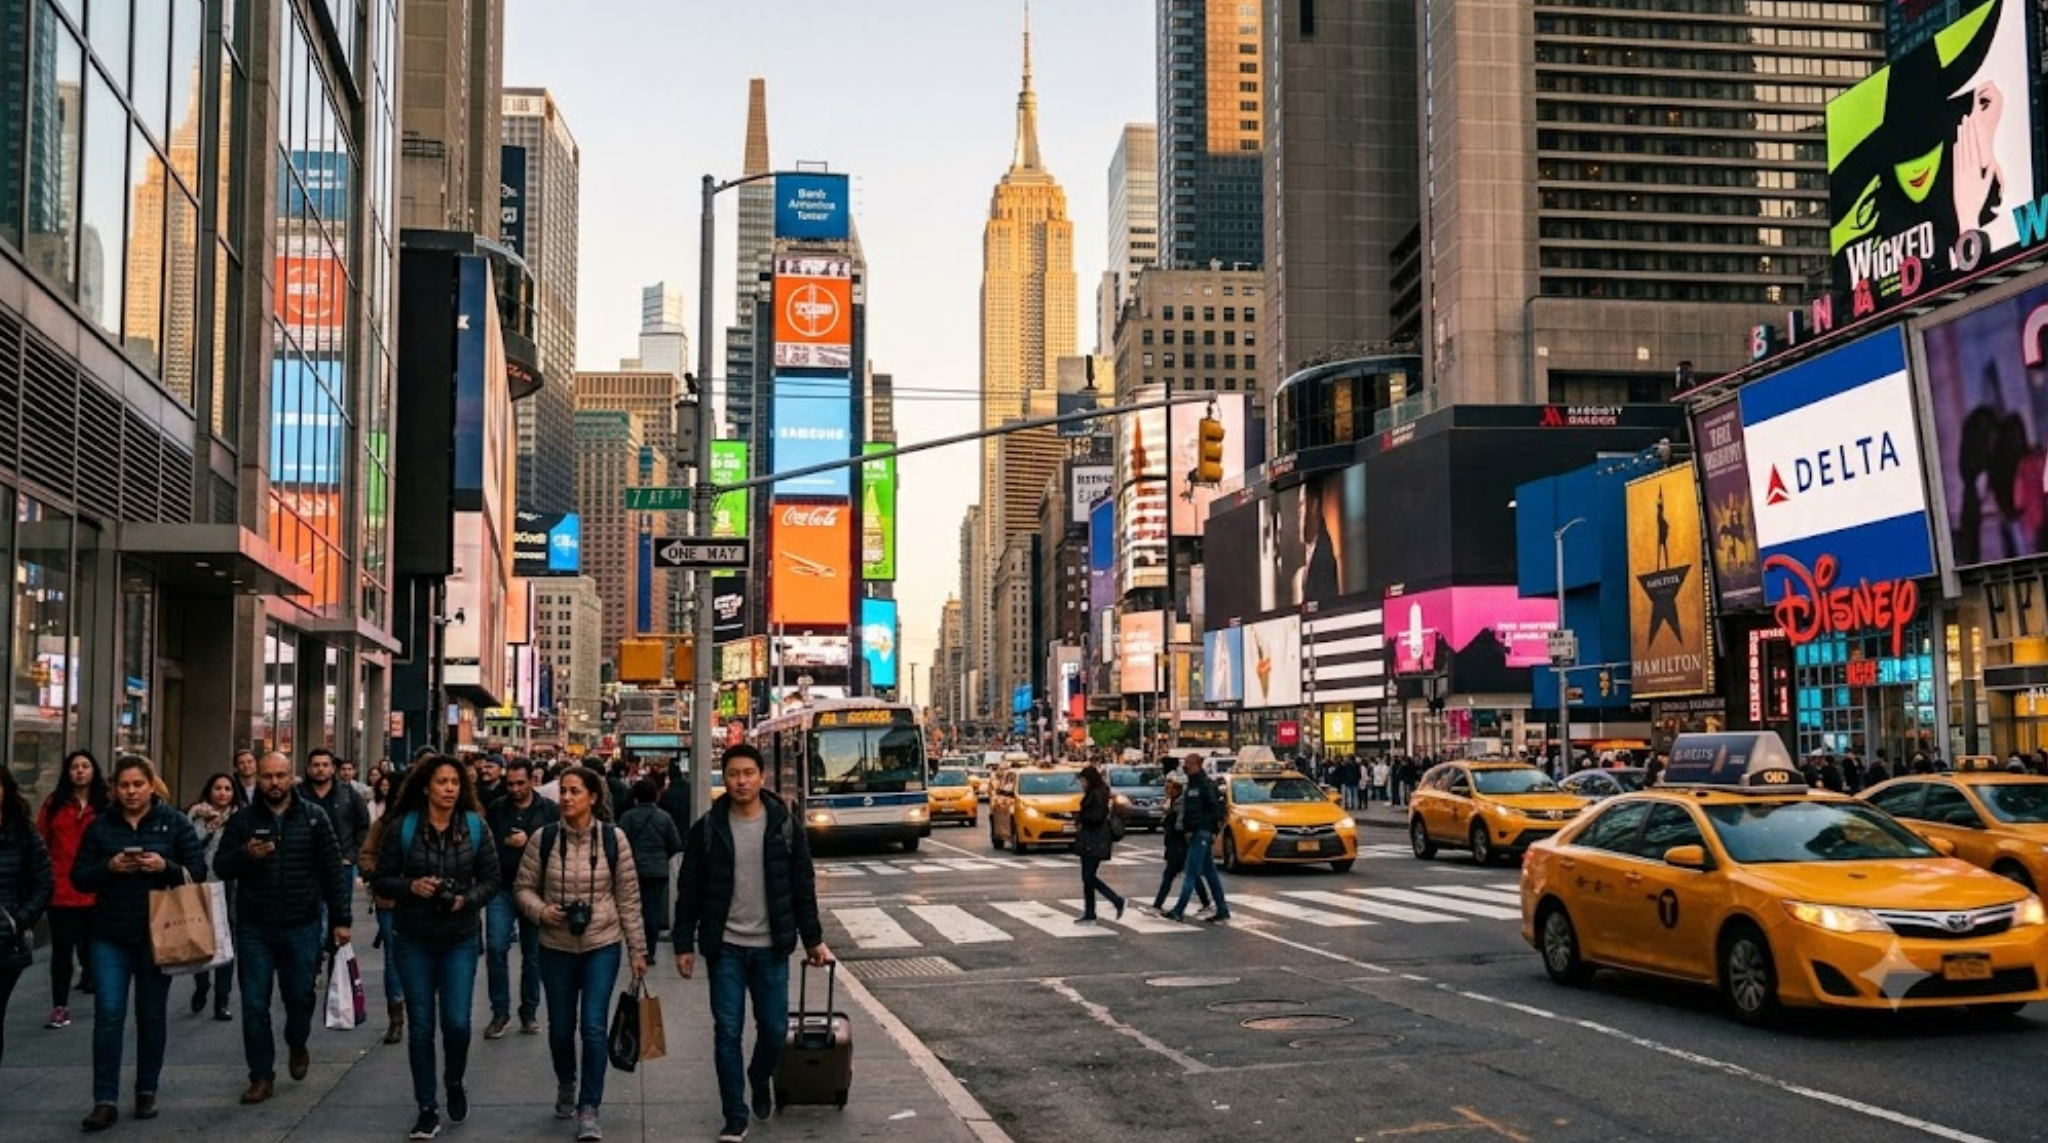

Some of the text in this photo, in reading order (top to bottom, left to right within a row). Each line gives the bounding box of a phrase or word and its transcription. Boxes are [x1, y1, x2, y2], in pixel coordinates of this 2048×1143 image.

[1795, 431, 1900, 494] DELTA
[668, 547, 738, 560] ONE WAY
[1632, 653, 1702, 677] HAMILTON
